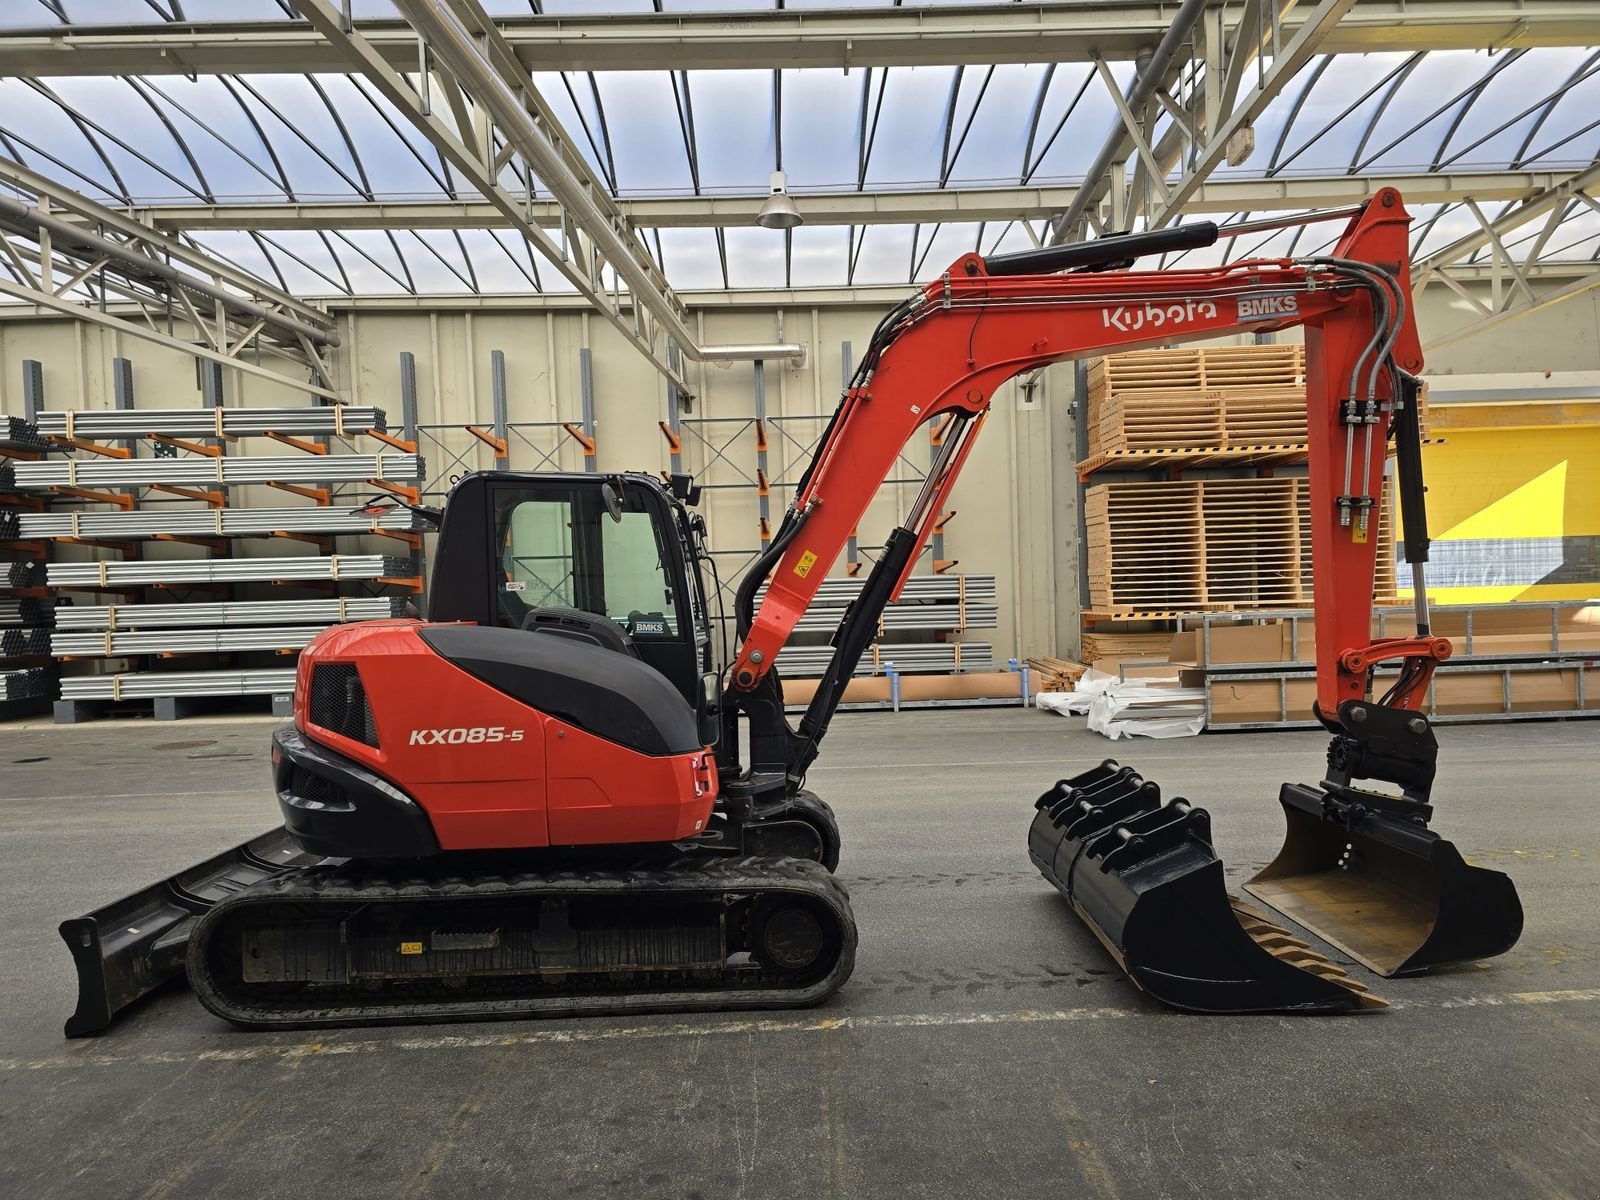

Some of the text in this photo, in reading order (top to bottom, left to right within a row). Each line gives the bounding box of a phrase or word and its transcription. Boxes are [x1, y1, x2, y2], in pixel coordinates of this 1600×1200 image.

[1102, 298, 1217, 332] Kubota
[1237, 295, 1298, 317] BMKS
[636, 623, 663, 632] BMKS
[408, 726, 525, 746] KX085-5
